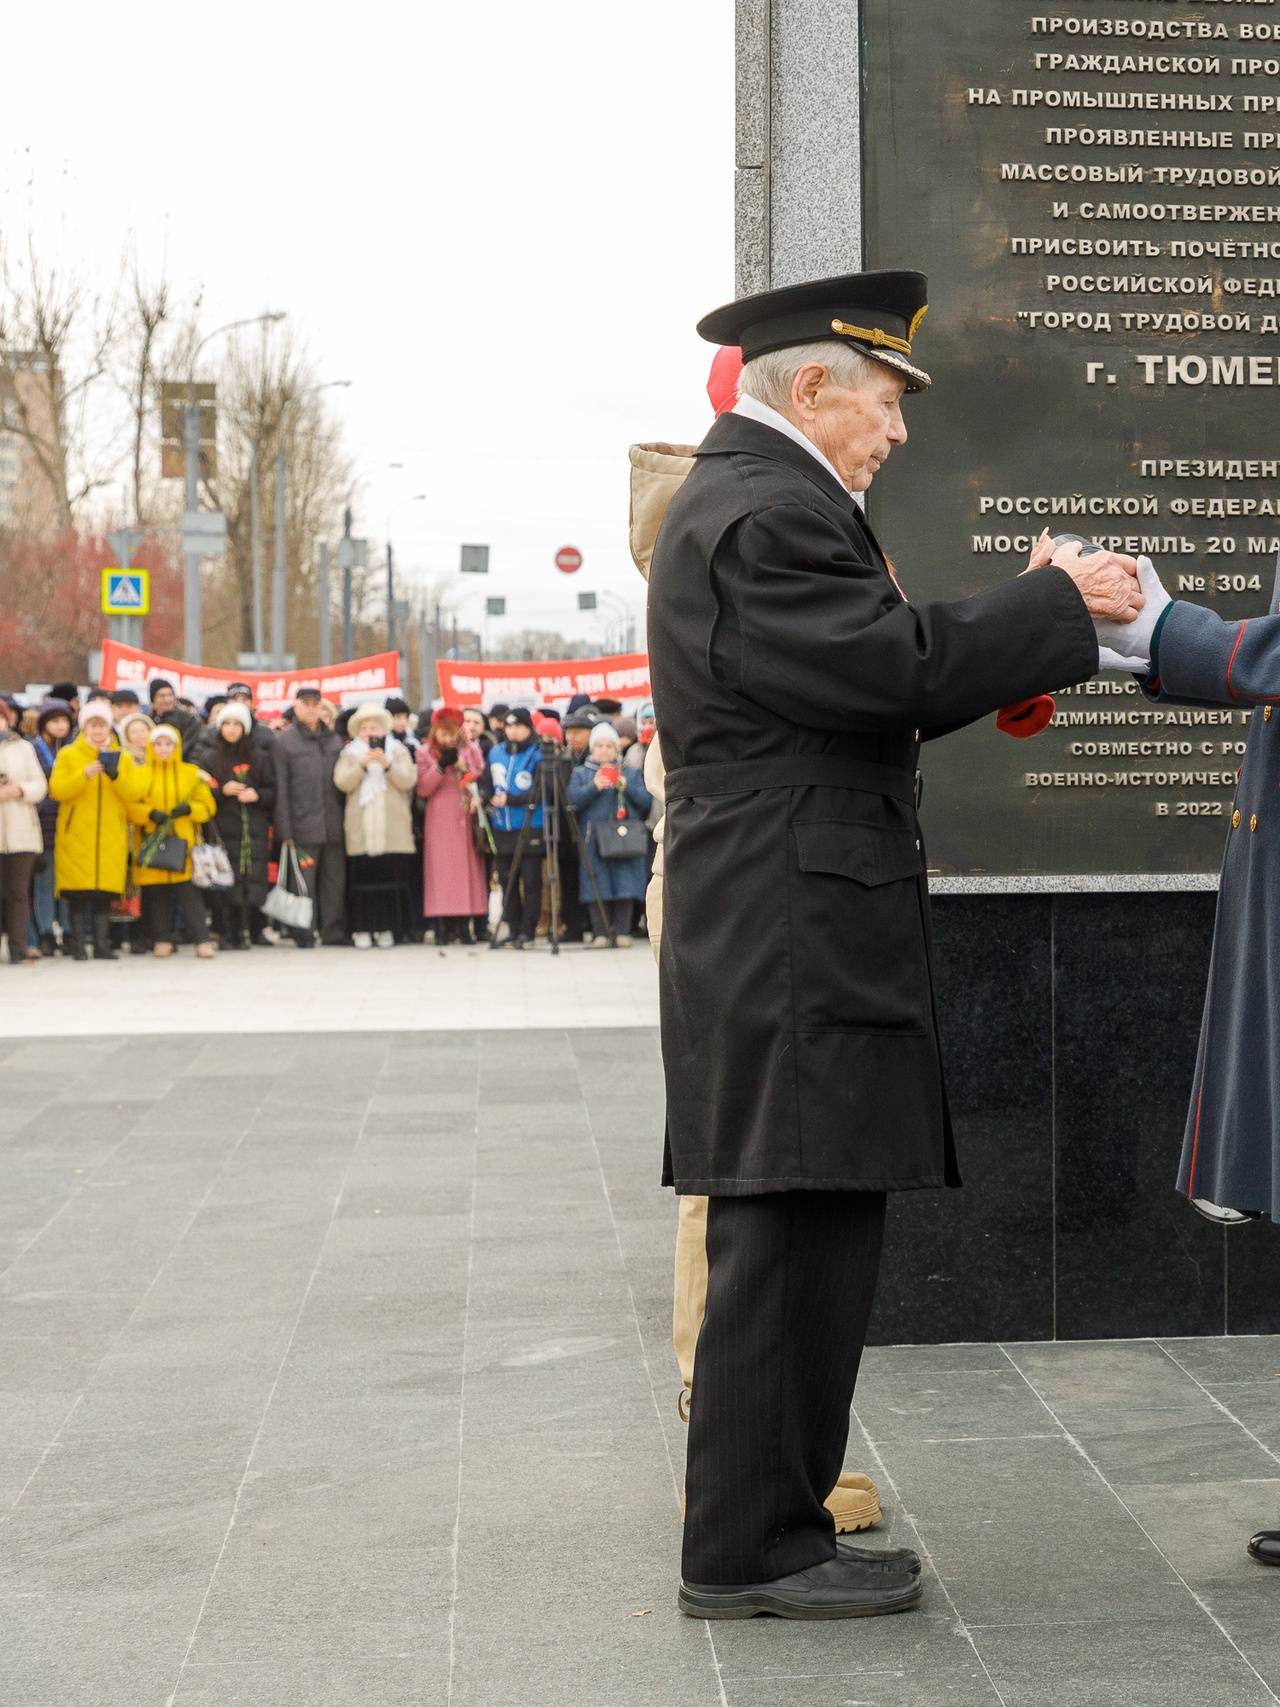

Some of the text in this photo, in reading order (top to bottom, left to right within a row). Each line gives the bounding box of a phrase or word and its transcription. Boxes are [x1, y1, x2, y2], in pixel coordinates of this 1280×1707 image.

[1031, 17, 1229, 39] ПРОИЗВОДСТВА
[1034, 53, 1220, 75] ГРАЖДАНСКОЙ
[968, 88, 1001, 105] НА
[1012, 89, 1233, 111] ПРОМЫШЛЕННЫХ
[1046, 127, 1233, 148] ПРОЯВЛЕННЫЕ
[1001, 163, 1143, 184] МАССОВЫЙ
[1053, 202, 1068, 219] И
[1012, 238, 1160, 257] ПРИСВОИТЬ
[1047, 274, 1213, 295] РОССИЙСКОЙ
[1017, 312, 1111, 332] "ГОРОД
[1120, 312, 1250, 333] ТРУДОВОЙ
[1086, 361, 1117, 384] г.
[979, 494, 1159, 515] РОССИЙСКОЙ
[1206, 537, 1236, 553] 20
[1179, 575, 1261, 592] № 304
[1050, 710, 1233, 727] ДМИНИСТРАЦИЕЙ
[1072, 742, 1192, 756] СОВМЕСТНО
[1201, 742, 1213, 755] С
[1156, 802, 1222, 816] В 2022
